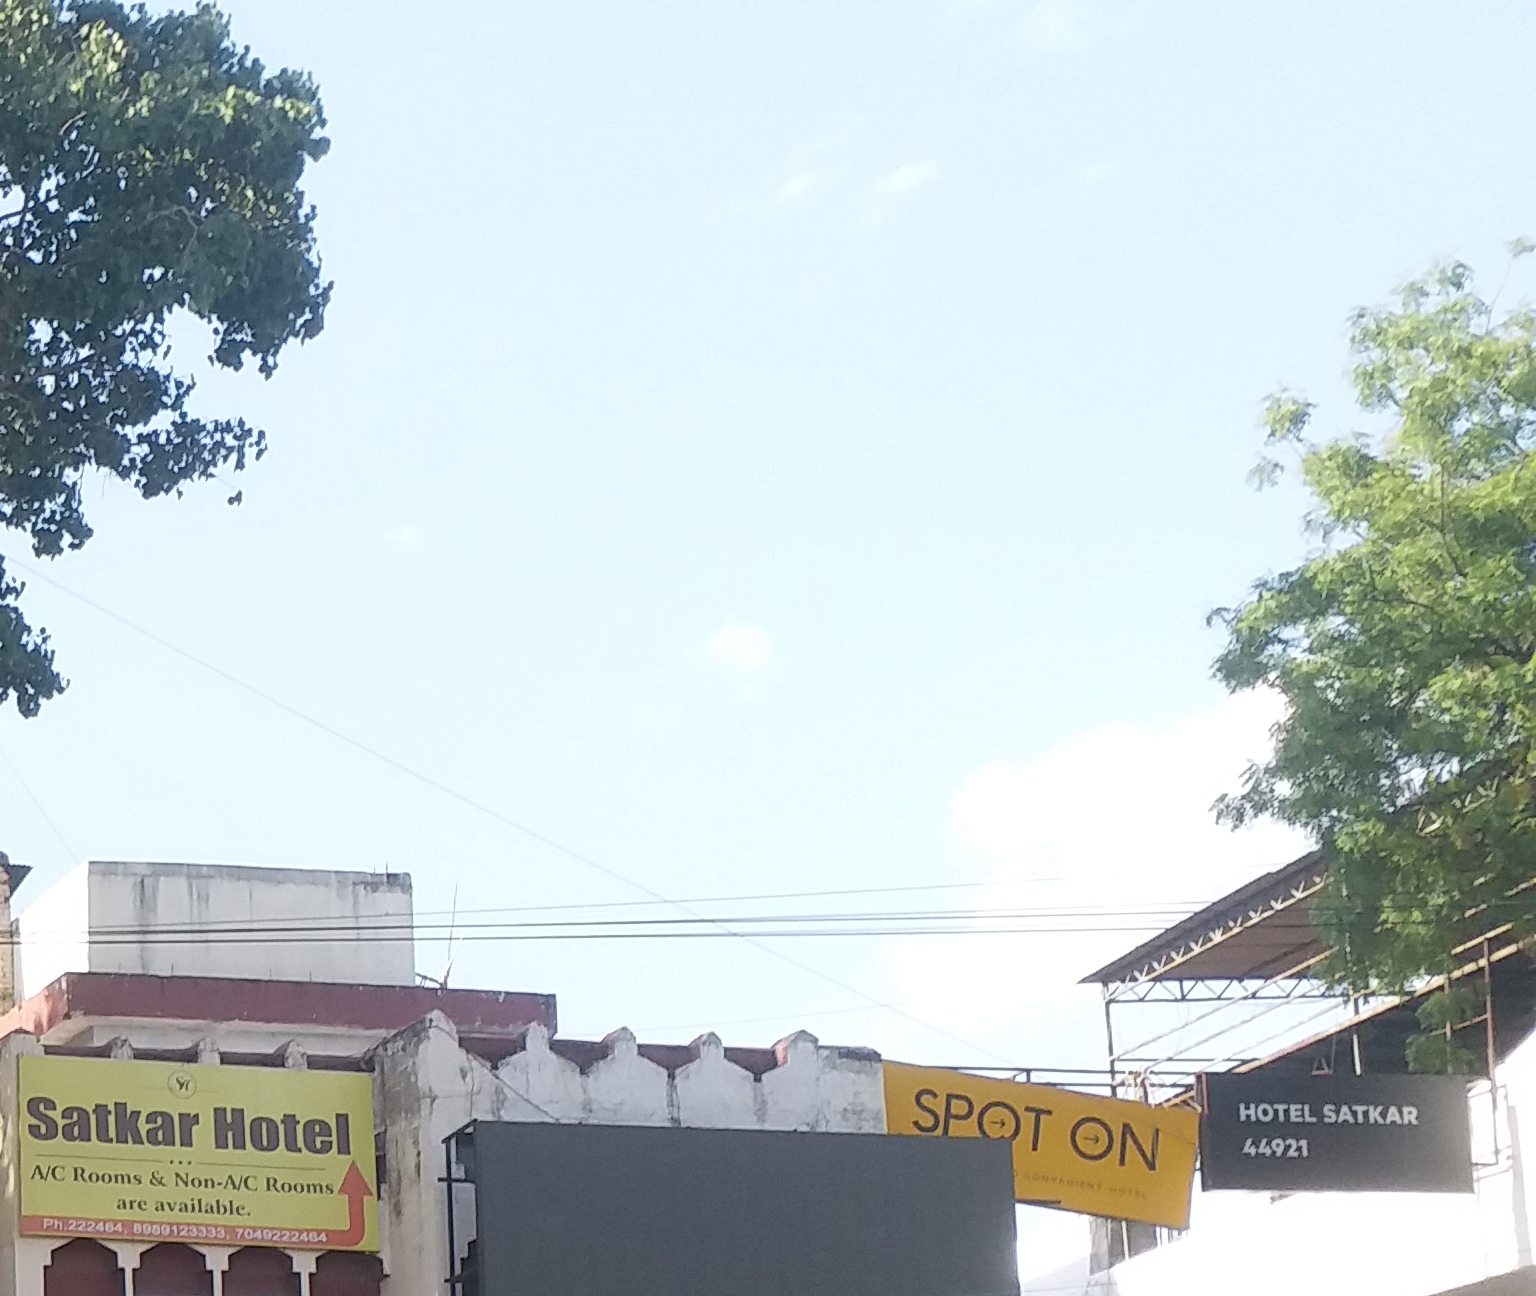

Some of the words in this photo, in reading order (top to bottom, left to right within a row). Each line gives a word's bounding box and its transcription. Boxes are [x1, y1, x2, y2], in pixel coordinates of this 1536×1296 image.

[26, 1095, 200, 1149] Satkar
[213, 1106, 352, 1157] Hotel
[1238, 1102, 1317, 1123] HOTEL
[1322, 1103, 1419, 1126] SATKAR
[911, 1088, 1053, 1152] SPOT
[1070, 1116, 1160, 1171] ON
[1242, 1138, 1309, 1158] 44921
[30, 1164, 65, 1183] A/C
[73, 1168, 142, 1187] Rooms
[149, 1171, 167, 1187] &
[174, 1171, 258, 1192] Non-A/C
[265, 1176, 335, 1196] Rooms
[116, 1198, 148, 1211] are
[154, 1198, 252, 1218] available.
